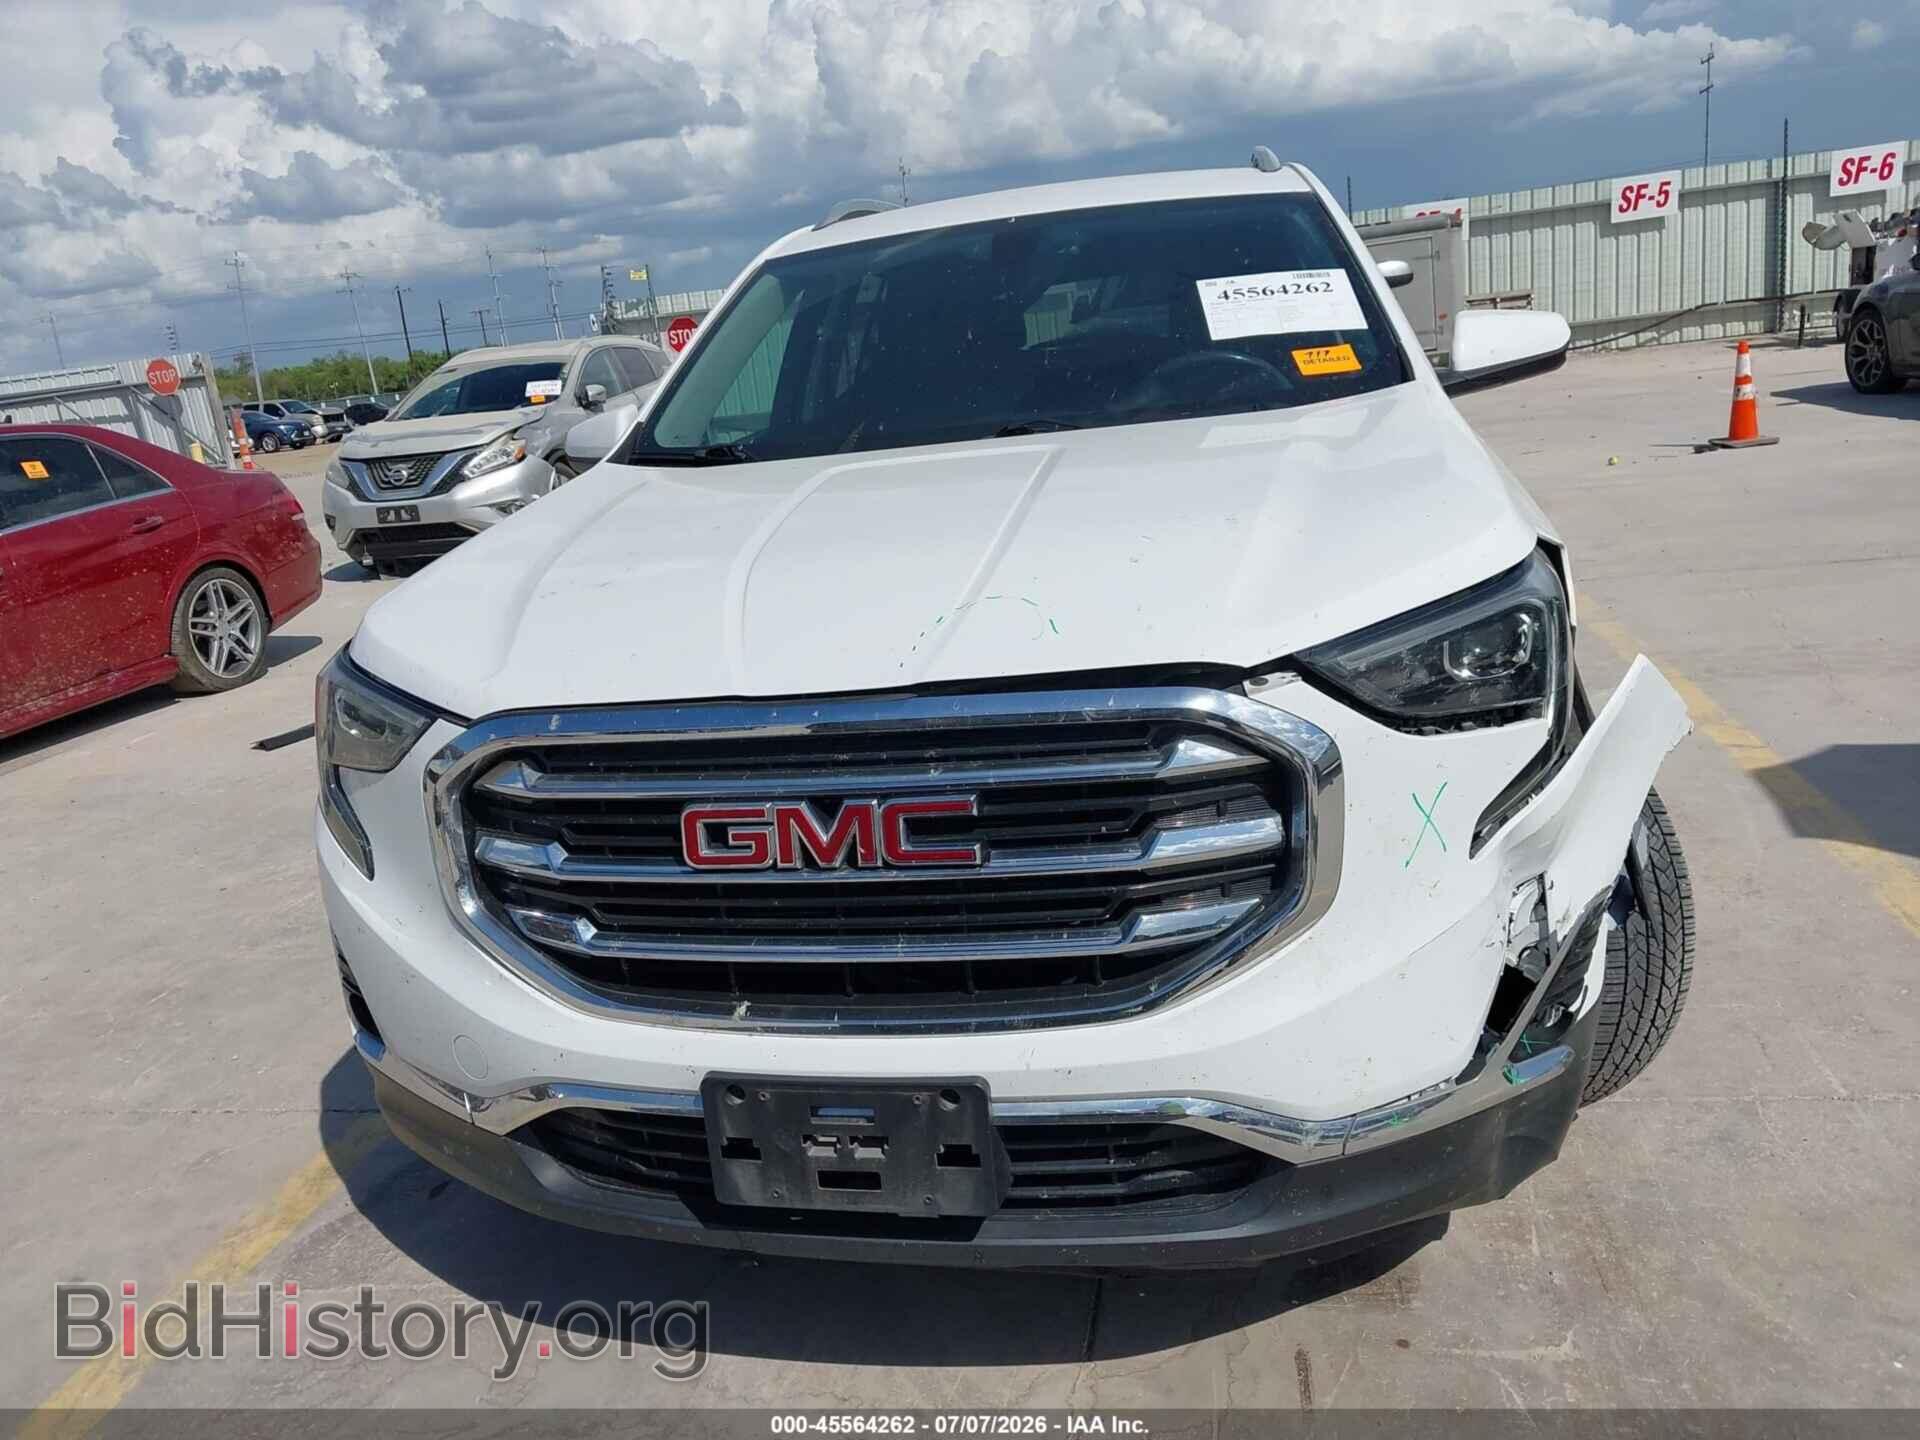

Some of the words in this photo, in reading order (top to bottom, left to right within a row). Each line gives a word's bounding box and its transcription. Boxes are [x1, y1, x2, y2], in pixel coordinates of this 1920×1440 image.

[1838, 152, 1896, 186] SF-6
[1618, 181, 1671, 213] SF-5
[1217, 282, 1334, 300] 45564262
[148, 368, 176, 385] STOP
[681, 795, 985, 870] GMC
